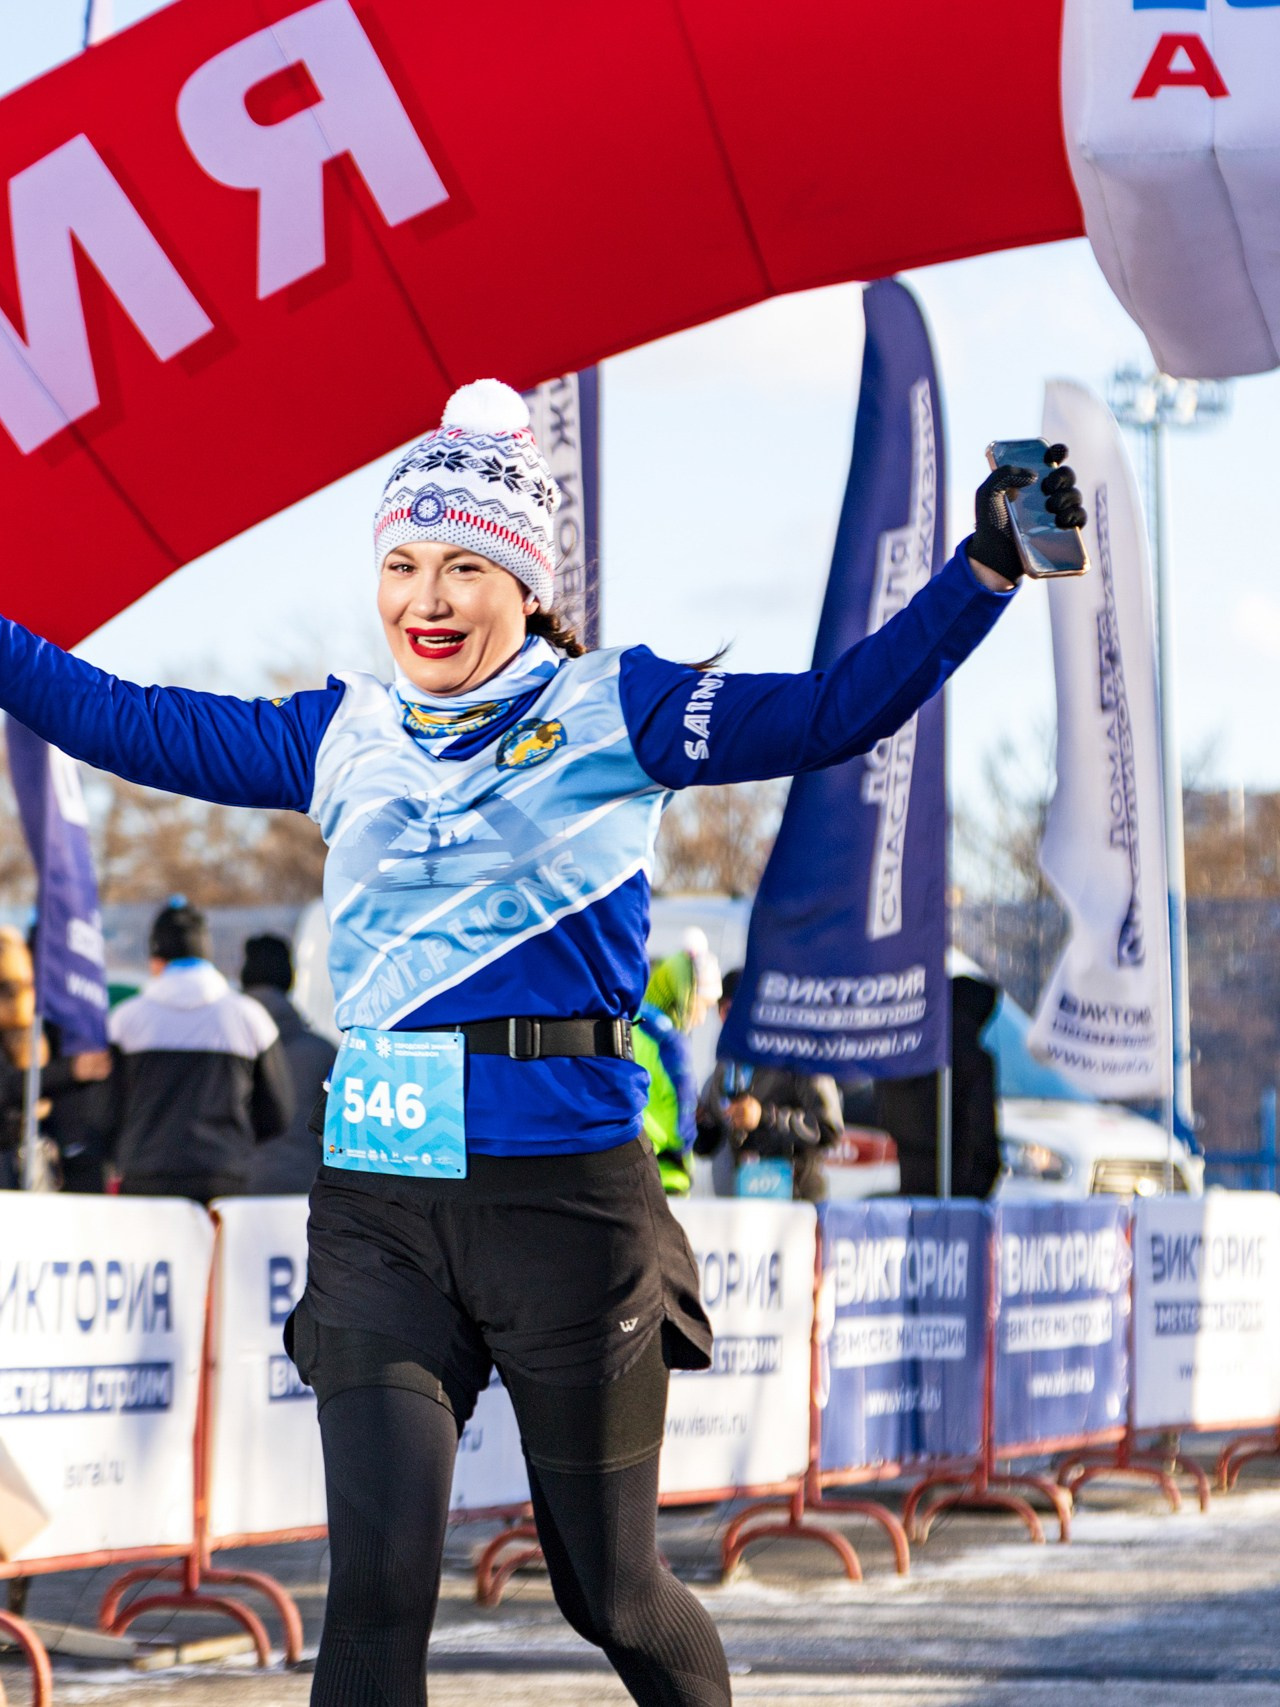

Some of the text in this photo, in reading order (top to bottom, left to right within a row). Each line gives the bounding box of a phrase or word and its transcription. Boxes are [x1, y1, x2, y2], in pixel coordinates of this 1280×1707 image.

[917, 391, 935, 572] ЖИЗНИ
[447, 850, 586, 951] LIONS
[762, 965, 926, 1005] ВИКТОРИЯ
[343, 1077, 427, 1130] 546
[694, 1251, 784, 1310] ОРИЯ
[835, 1238, 969, 1306] ВИКТОРИЯ
